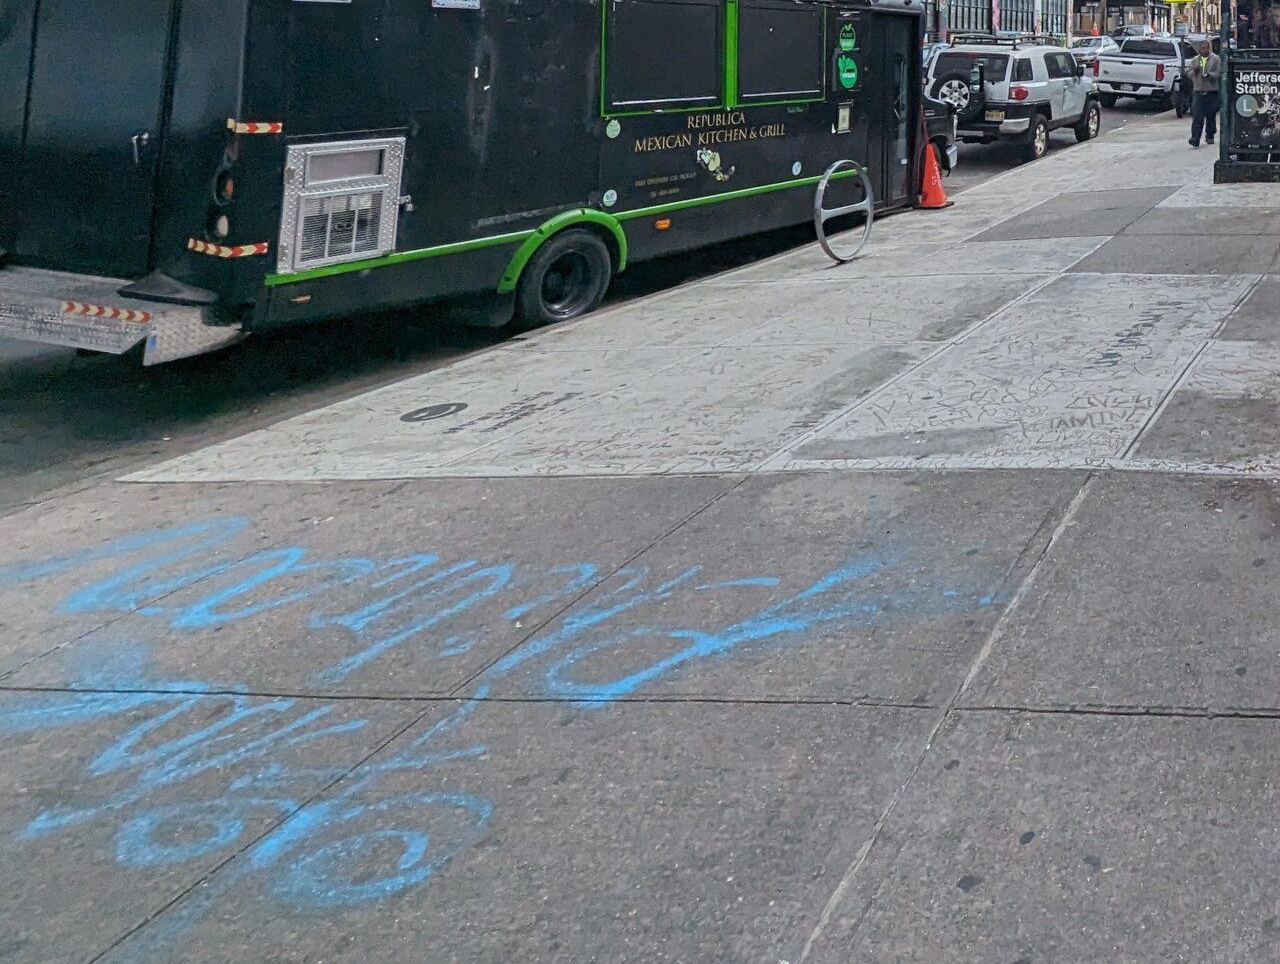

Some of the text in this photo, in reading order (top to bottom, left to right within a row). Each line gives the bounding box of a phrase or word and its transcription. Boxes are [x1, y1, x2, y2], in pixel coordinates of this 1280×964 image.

[1235, 83, 1278, 94] Station
[1243, 99, 1252, 111] L
[688, 112, 746, 129] REPUBLICA
[635, 124, 786, 152] MEXICAN KITCHEN & GRILL
